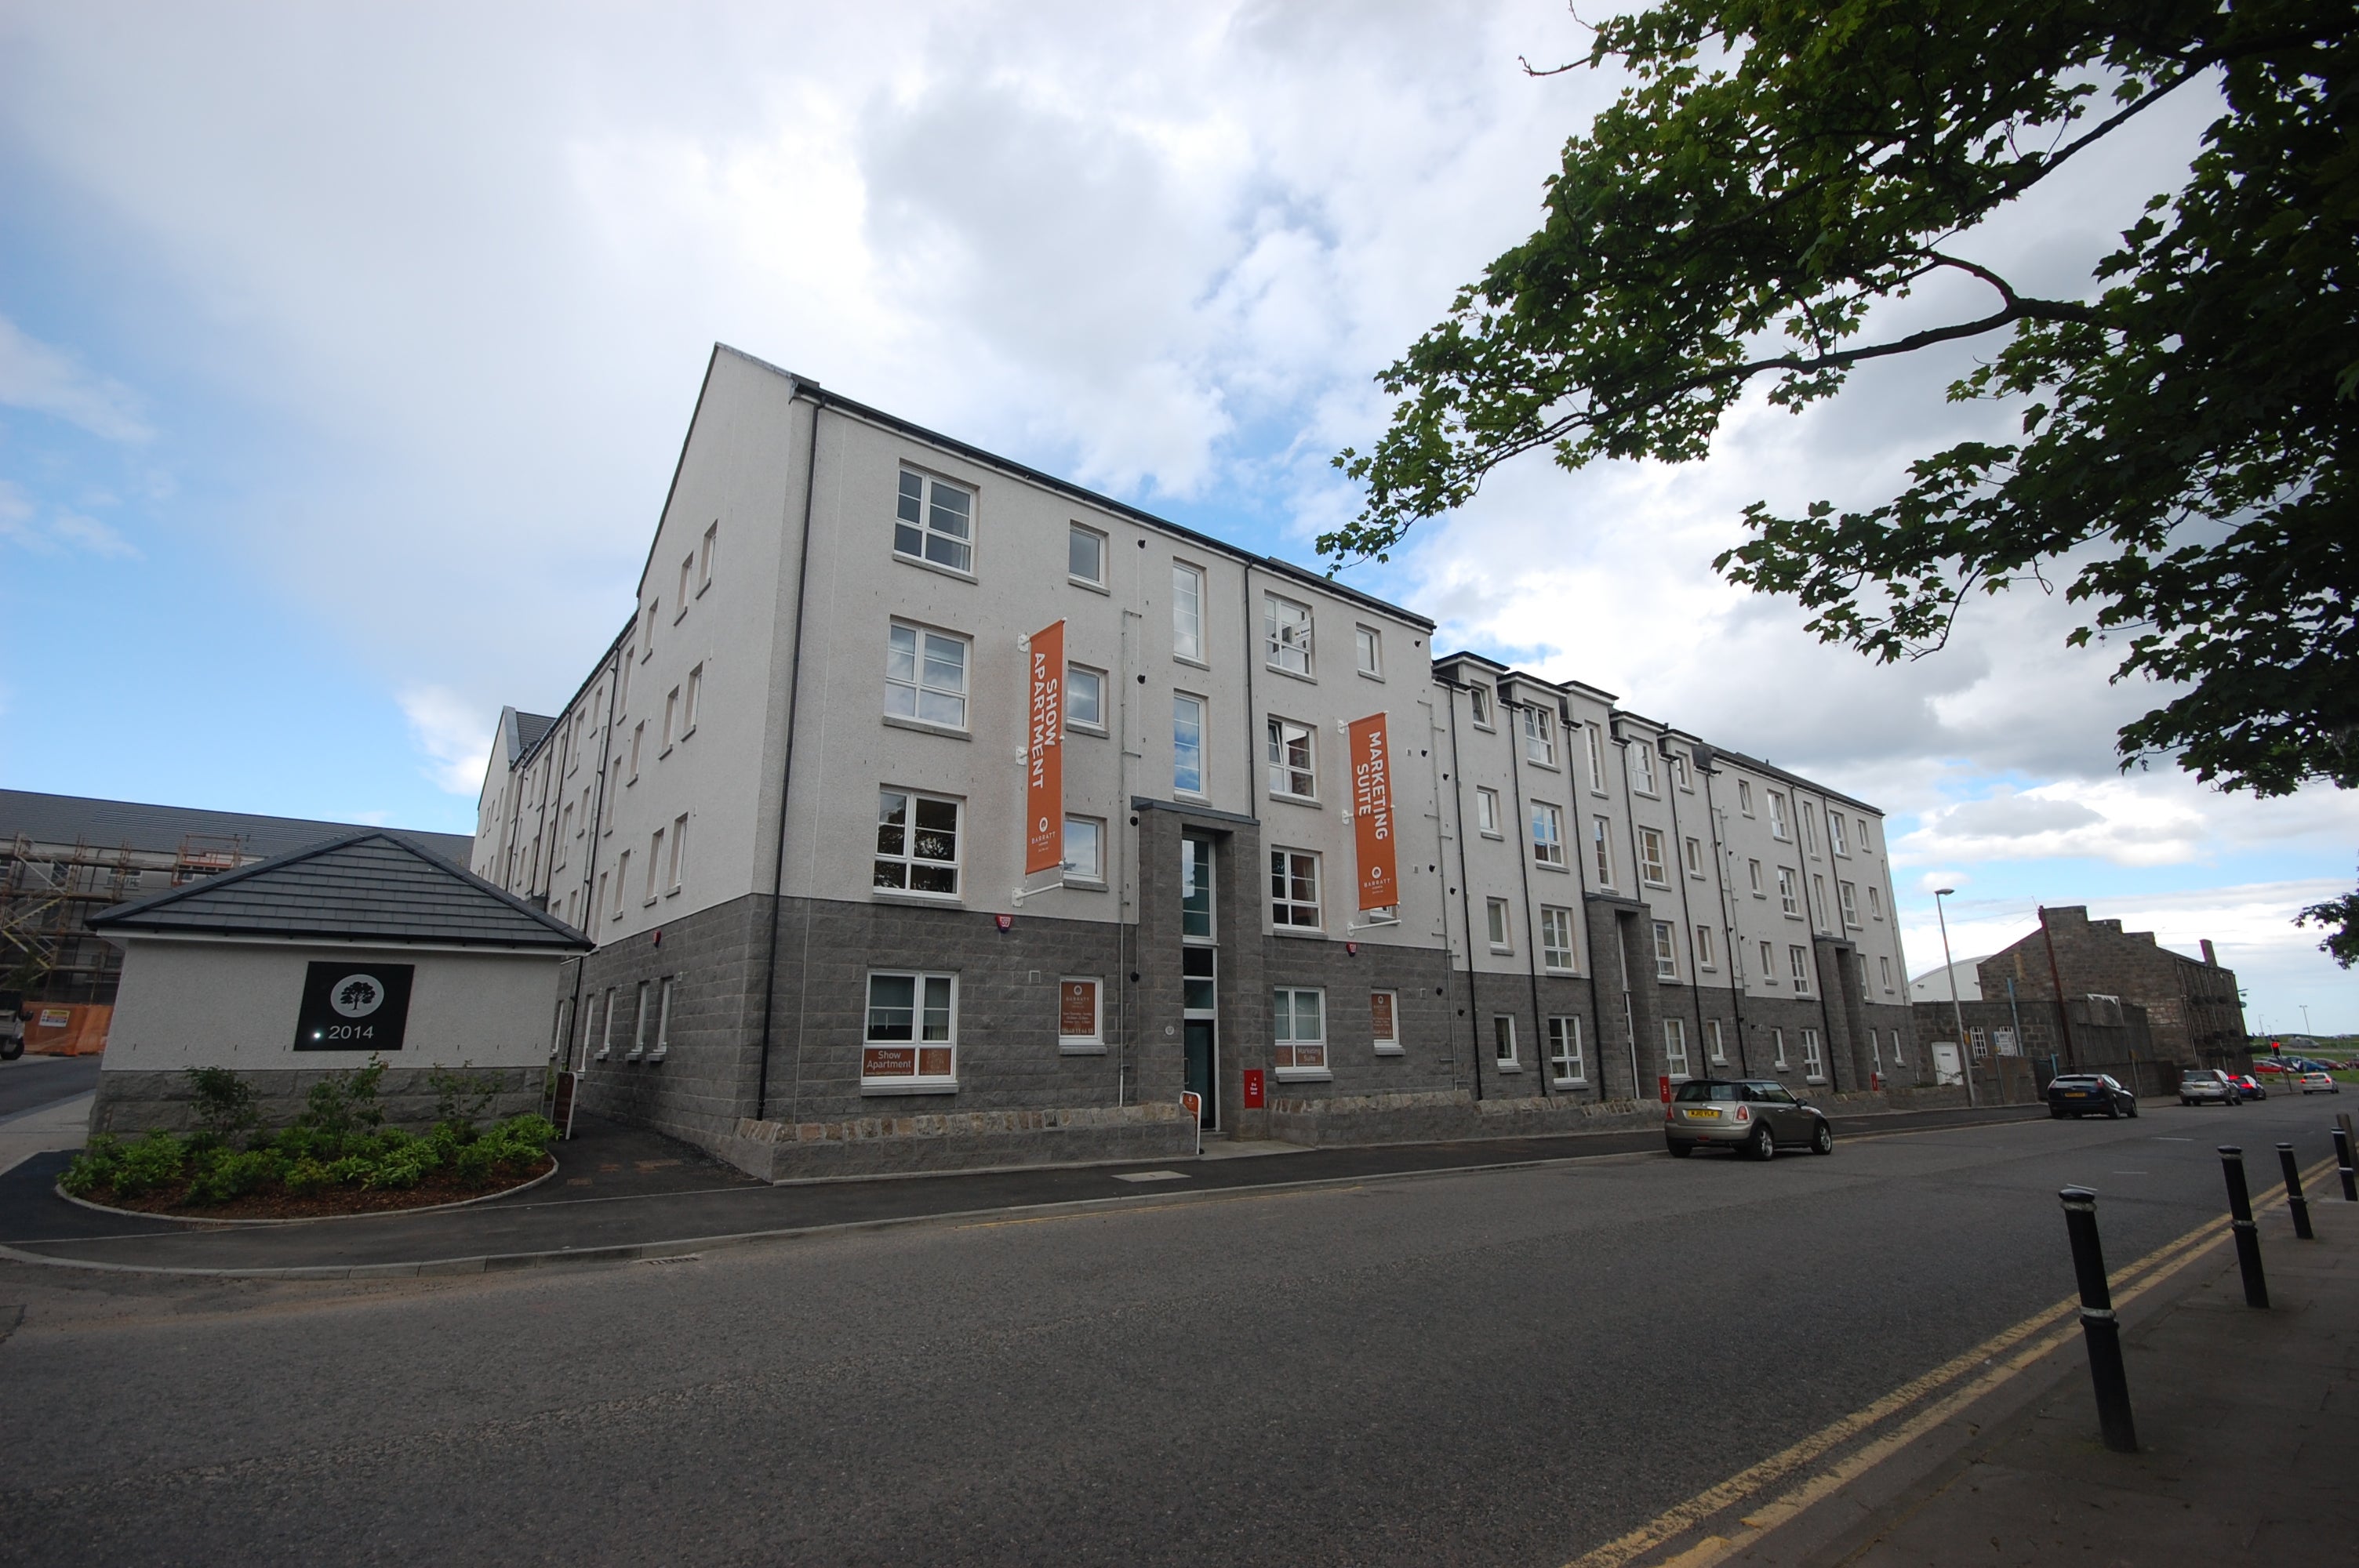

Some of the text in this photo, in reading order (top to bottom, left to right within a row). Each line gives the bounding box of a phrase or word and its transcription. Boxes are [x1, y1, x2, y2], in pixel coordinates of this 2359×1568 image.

[1045, 677, 1057, 746] SHOW
[1032, 652, 1046, 789] APARTMENT
[1357, 763, 1371, 816] SUITE
[1369, 731, 1388, 840] MARKETING
[1031, 831, 1056, 844] BARRATT
[328, 1025, 374, 1040] 2014
[878, 1050, 901, 1059] Show
[1297, 1047, 1321, 1055] Marketing
[867, 1060, 911, 1070] Apartment
